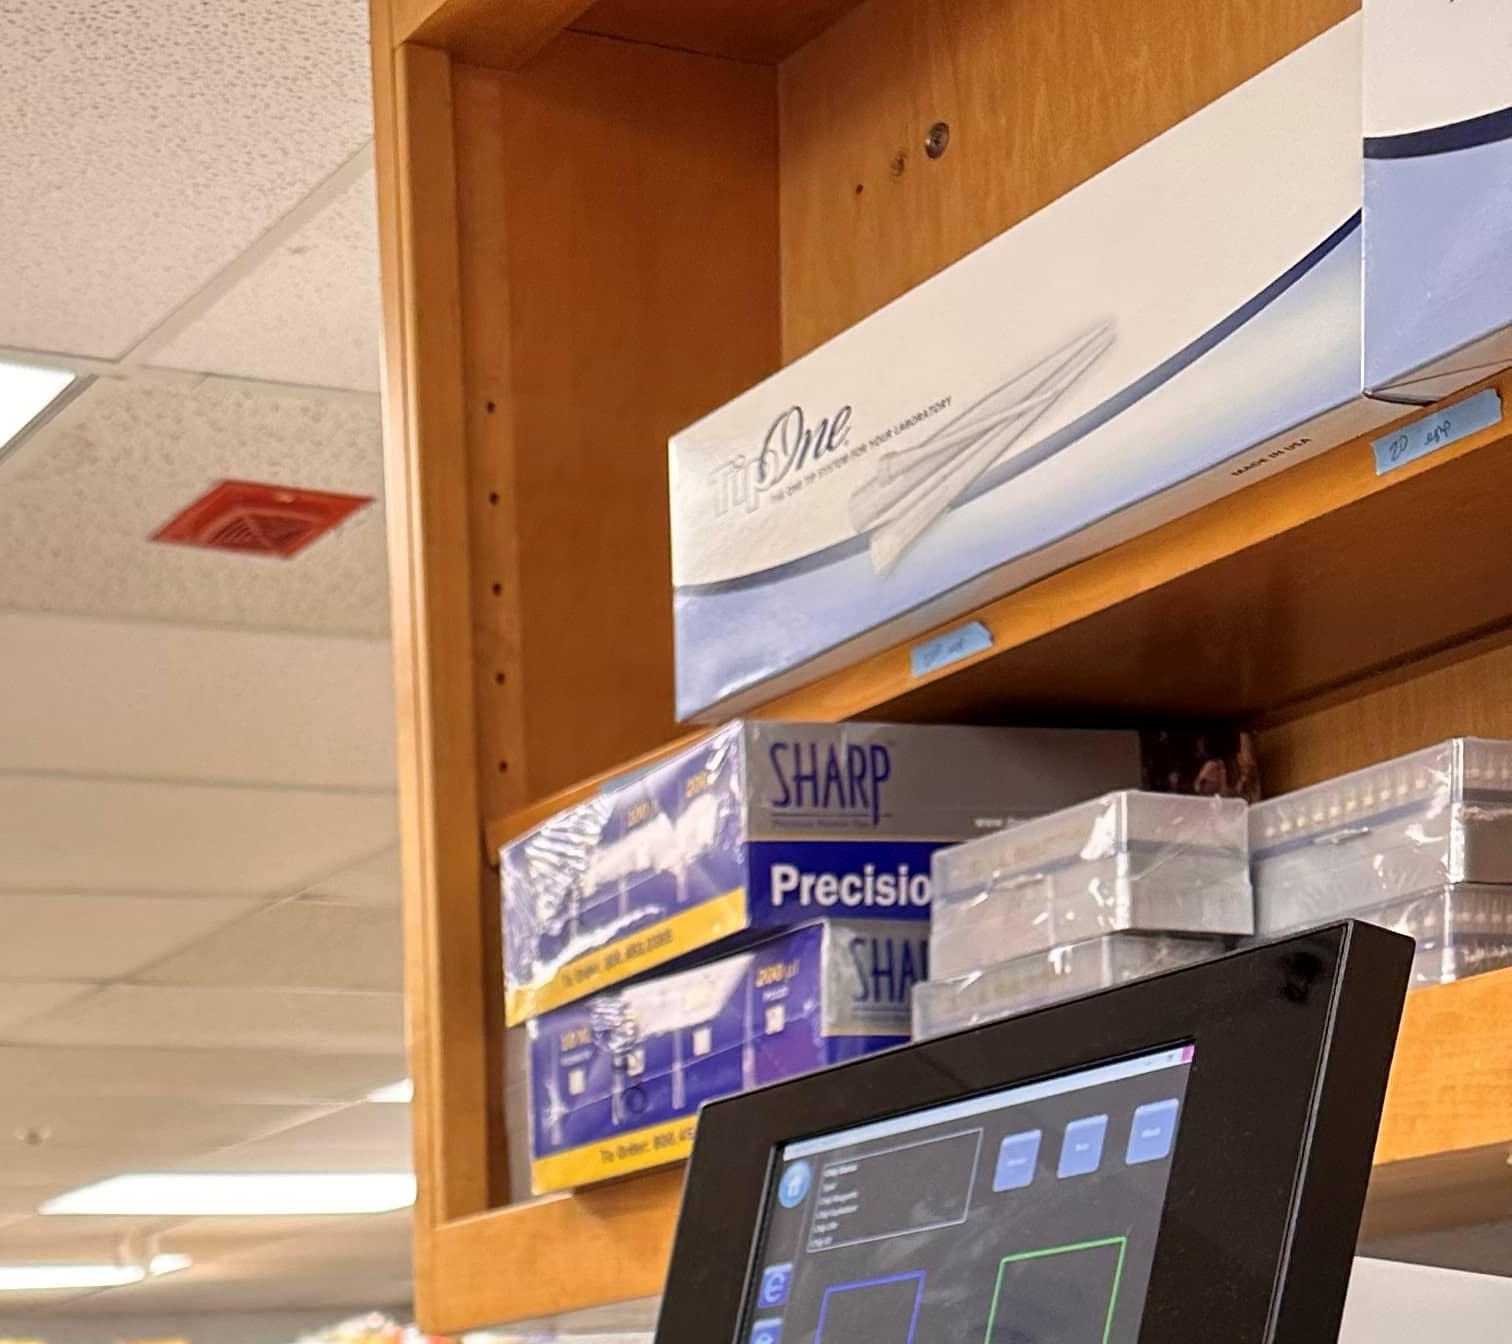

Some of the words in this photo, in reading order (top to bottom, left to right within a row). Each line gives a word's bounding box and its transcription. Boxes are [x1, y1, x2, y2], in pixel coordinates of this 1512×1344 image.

[769, 741, 891, 827] SHARP
[770, 864, 931, 907] Precisio
[850, 936, 928, 1003] SHA
